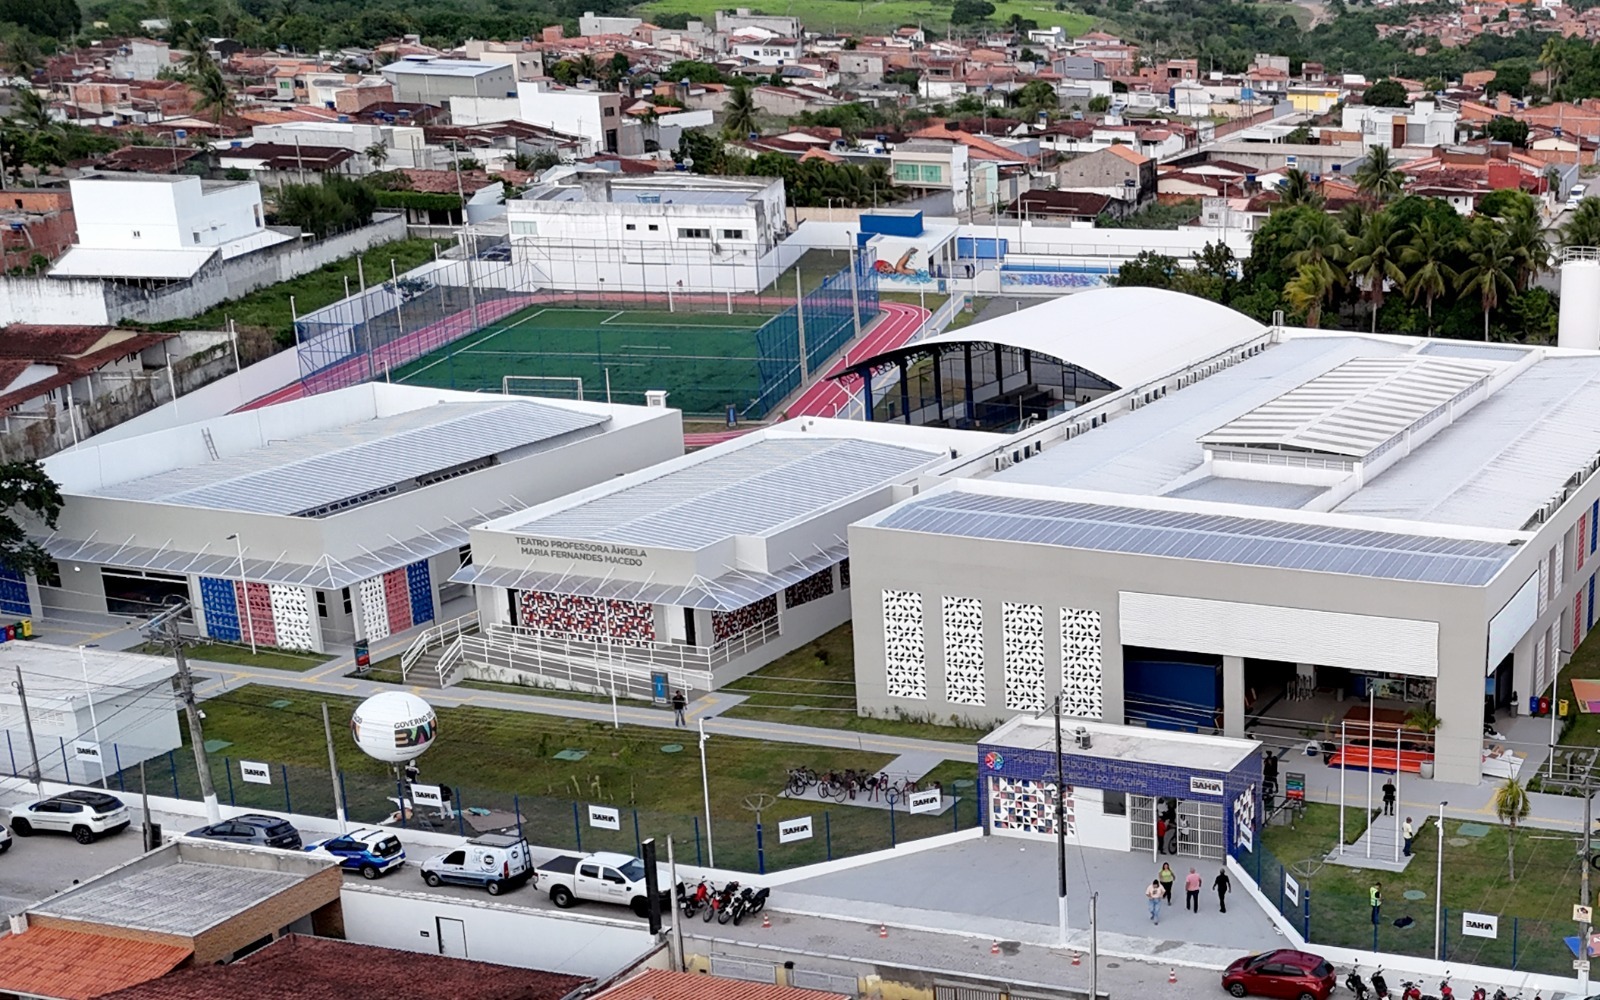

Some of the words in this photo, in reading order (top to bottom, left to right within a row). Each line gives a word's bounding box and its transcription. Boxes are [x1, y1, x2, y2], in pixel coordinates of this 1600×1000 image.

[515, 537, 549, 548] TEATRO
[551, 540, 610, 554] PROFESSORA
[521, 547, 549, 557] MARIA
[550, 550, 603, 562] FERNANDES
[604, 556, 642, 566] MACEDO
[394, 715, 428, 729] GOVERNO
[76, 747, 99, 757] BAHIA
[243, 768, 267, 778] BAHIA
[1191, 781, 1222, 792] BAHIA
[414, 790, 439, 801] BAHIA
[912, 796, 938, 807] BAHIA
[592, 813, 616, 823] BAHIA
[782, 824, 809, 836] BAHIA
[1465, 920, 1493, 931] BAHIA
